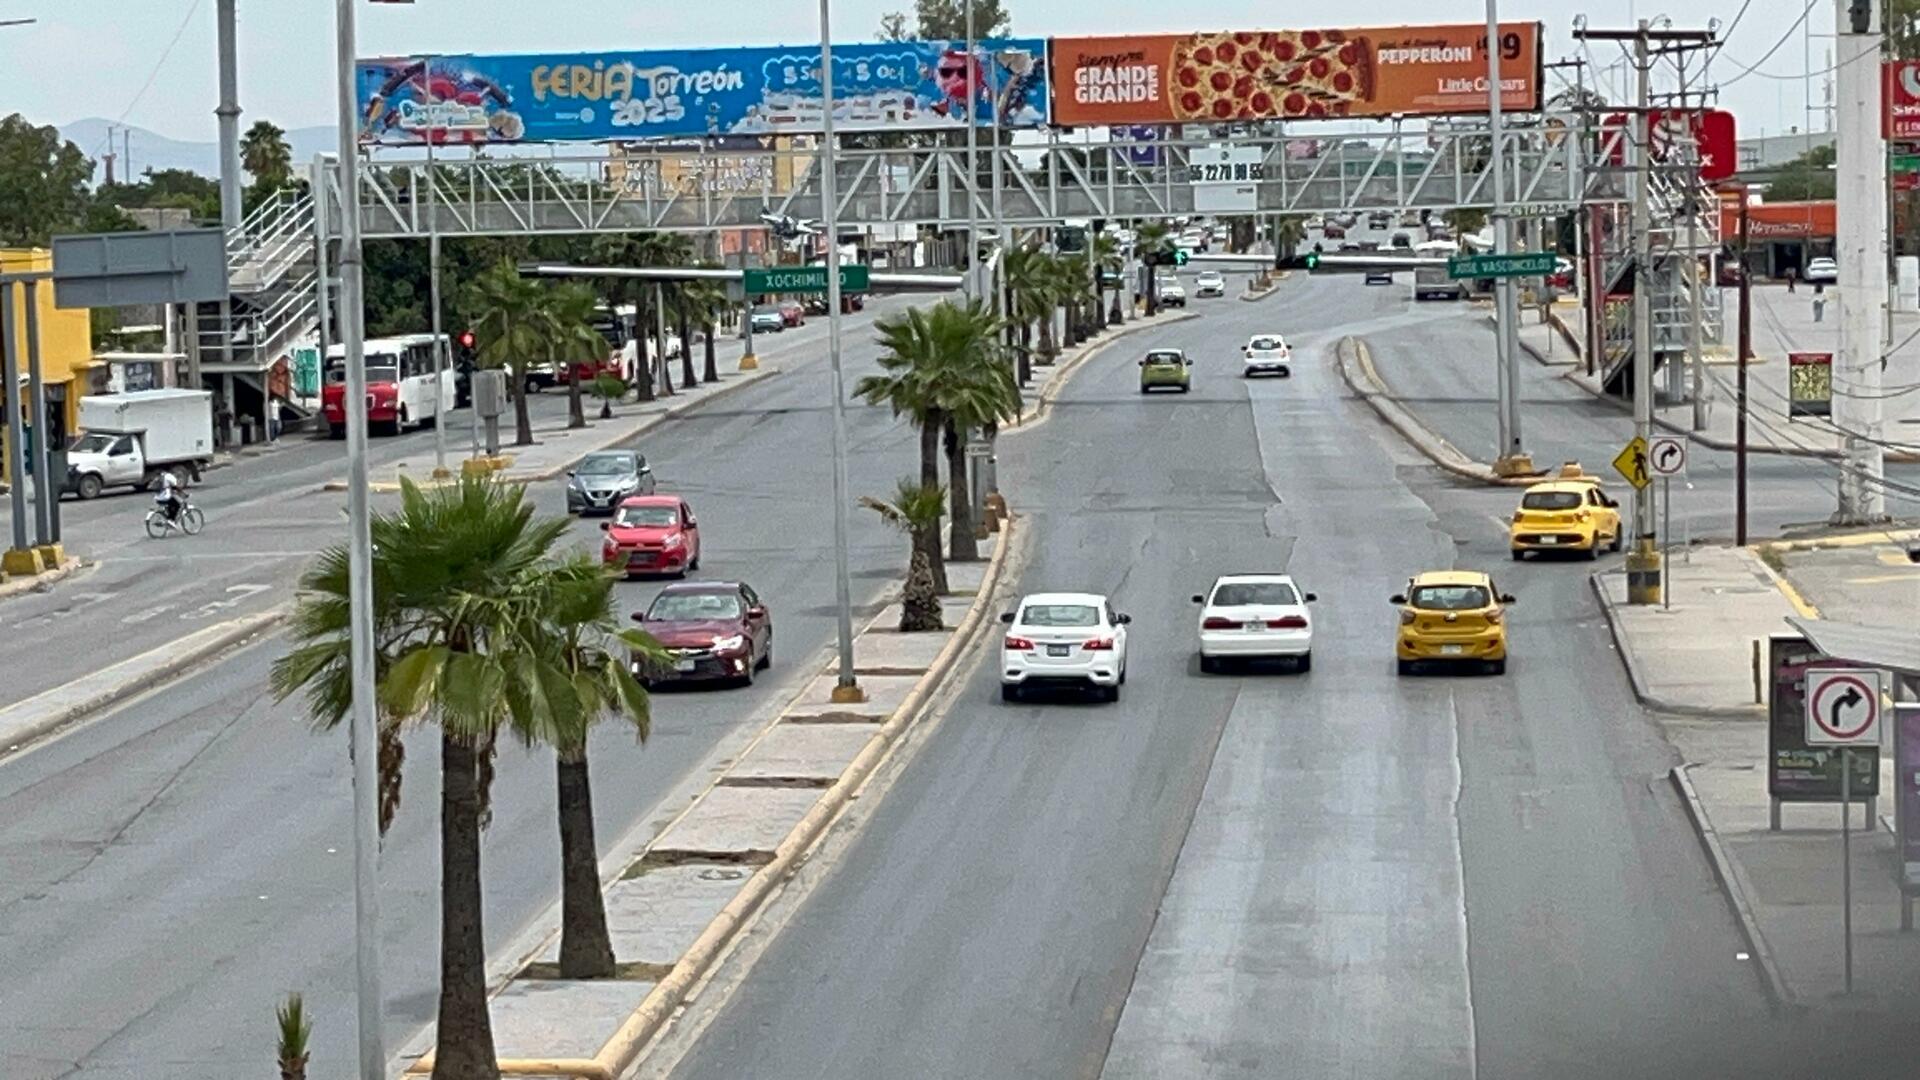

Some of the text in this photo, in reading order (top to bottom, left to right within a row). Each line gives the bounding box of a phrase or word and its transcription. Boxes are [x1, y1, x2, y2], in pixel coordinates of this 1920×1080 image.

[1377, 46, 1472, 65] PEPPERONI
[635, 63, 745, 99] Torreón
[1074, 65, 1158, 85] GRANDE
[1075, 83, 1159, 104] GRANDE
[1437, 78, 1473, 93] Little
[610, 96, 685, 127] 2025
[765, 272, 847, 288] XOCHIMILO
